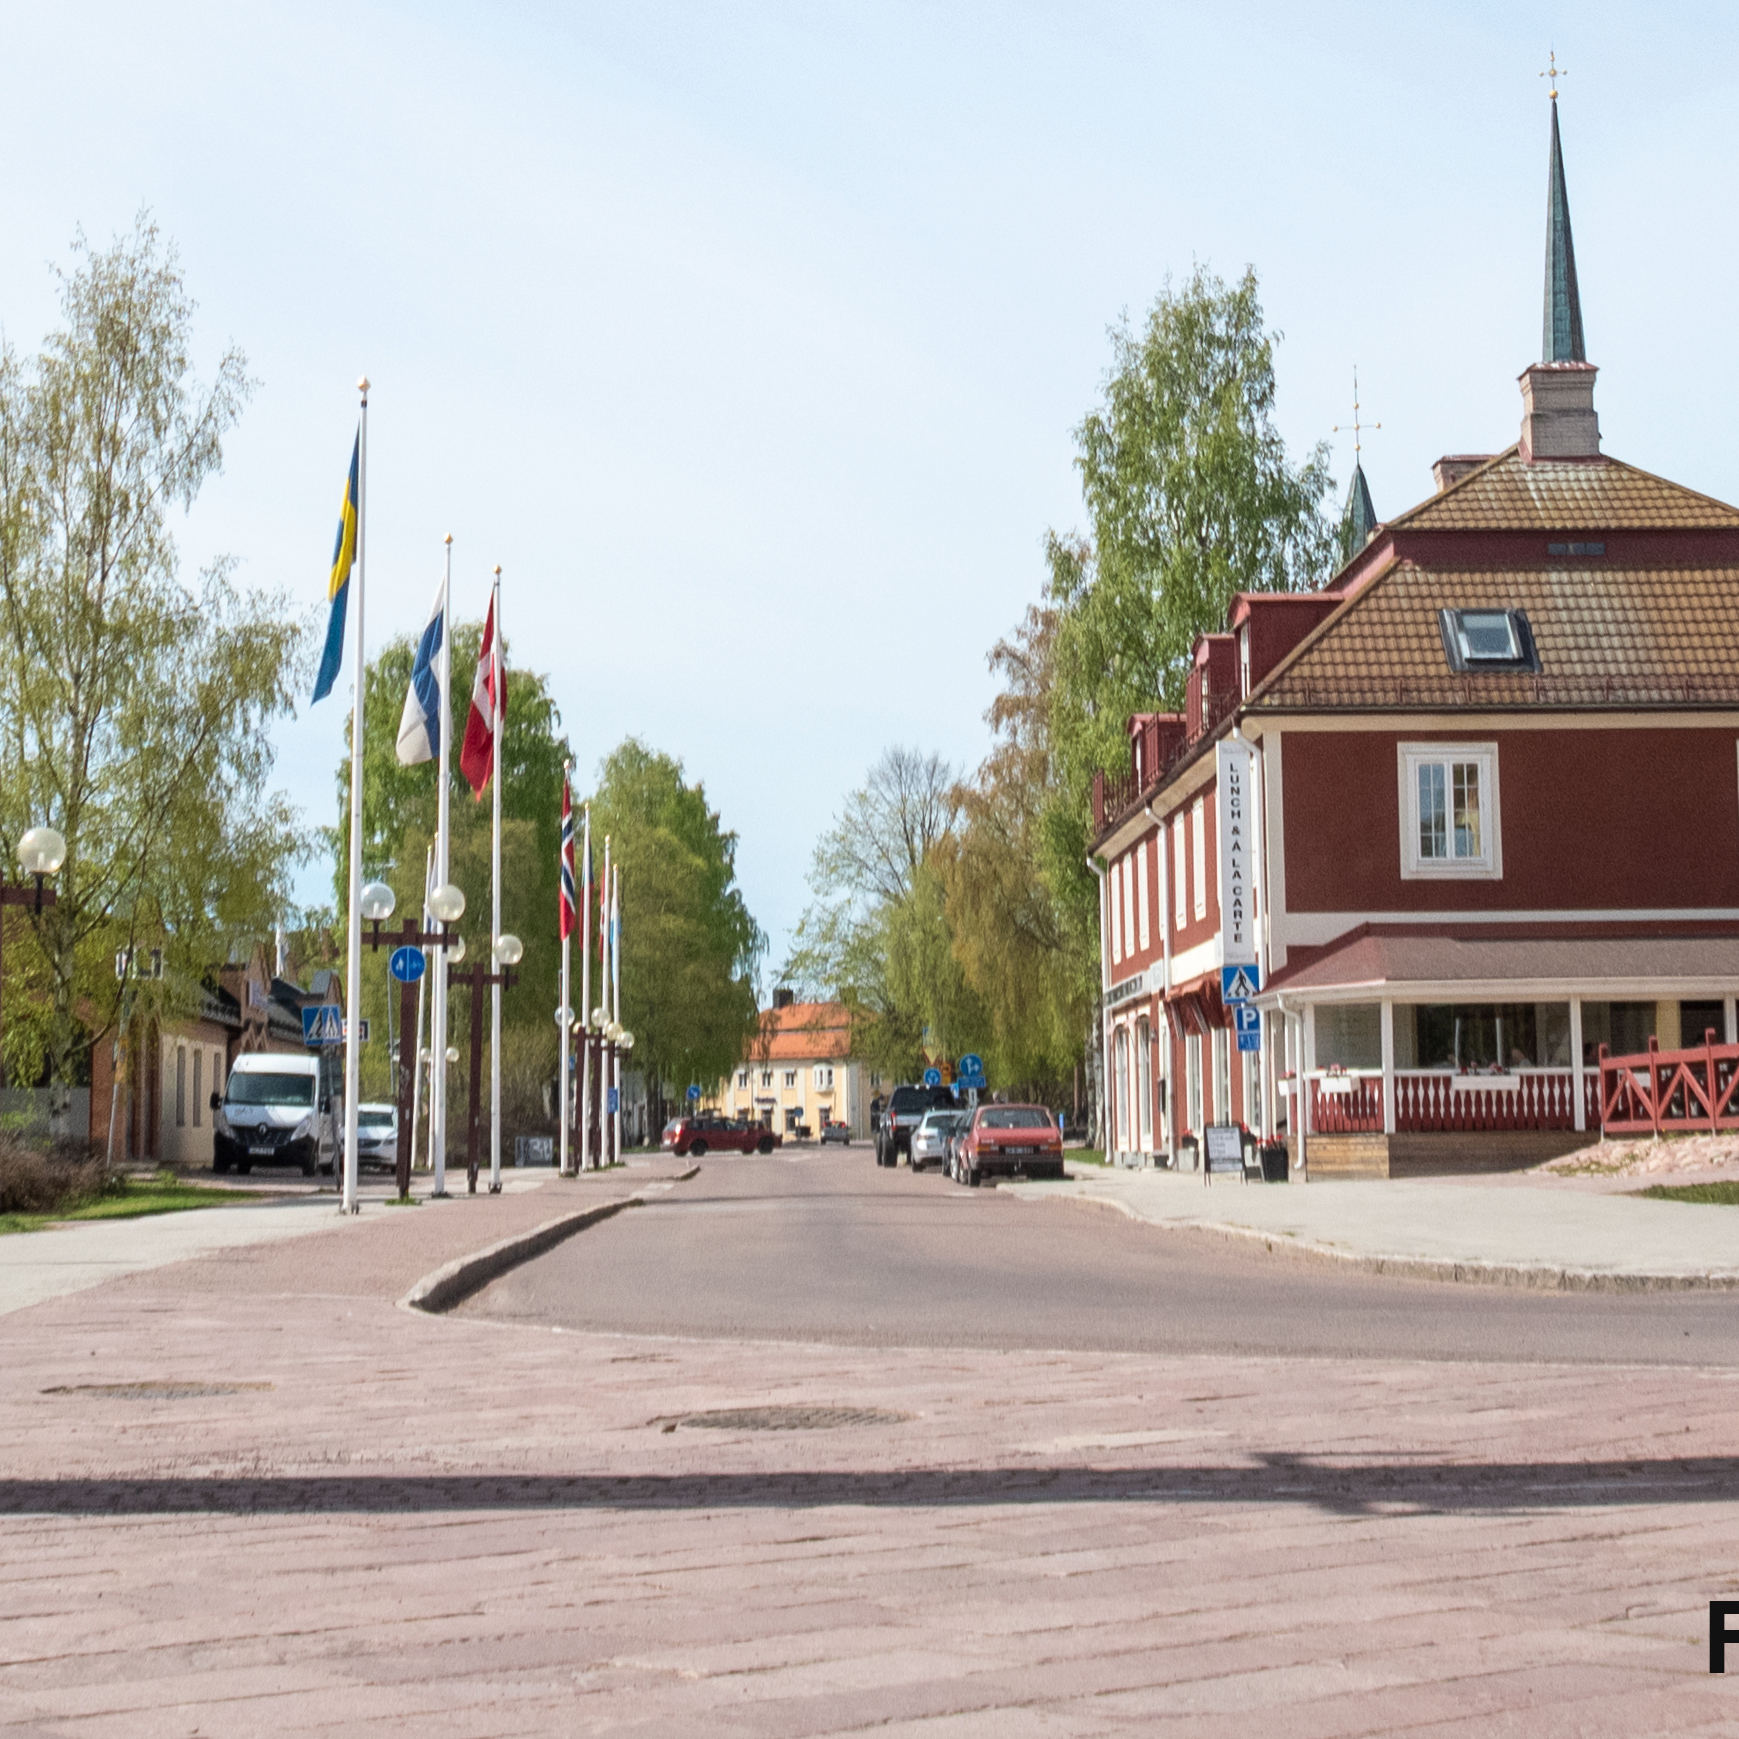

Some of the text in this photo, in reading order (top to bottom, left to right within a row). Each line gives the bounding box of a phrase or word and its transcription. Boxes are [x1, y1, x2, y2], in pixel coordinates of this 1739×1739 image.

[1230, 762, 1241, 820] LUNCH
[1231, 824, 1241, 836] &
[1232, 858, 1242, 881] LA
[1232, 885, 1244, 944] CARTE
[1242, 1009, 1257, 1031] P
